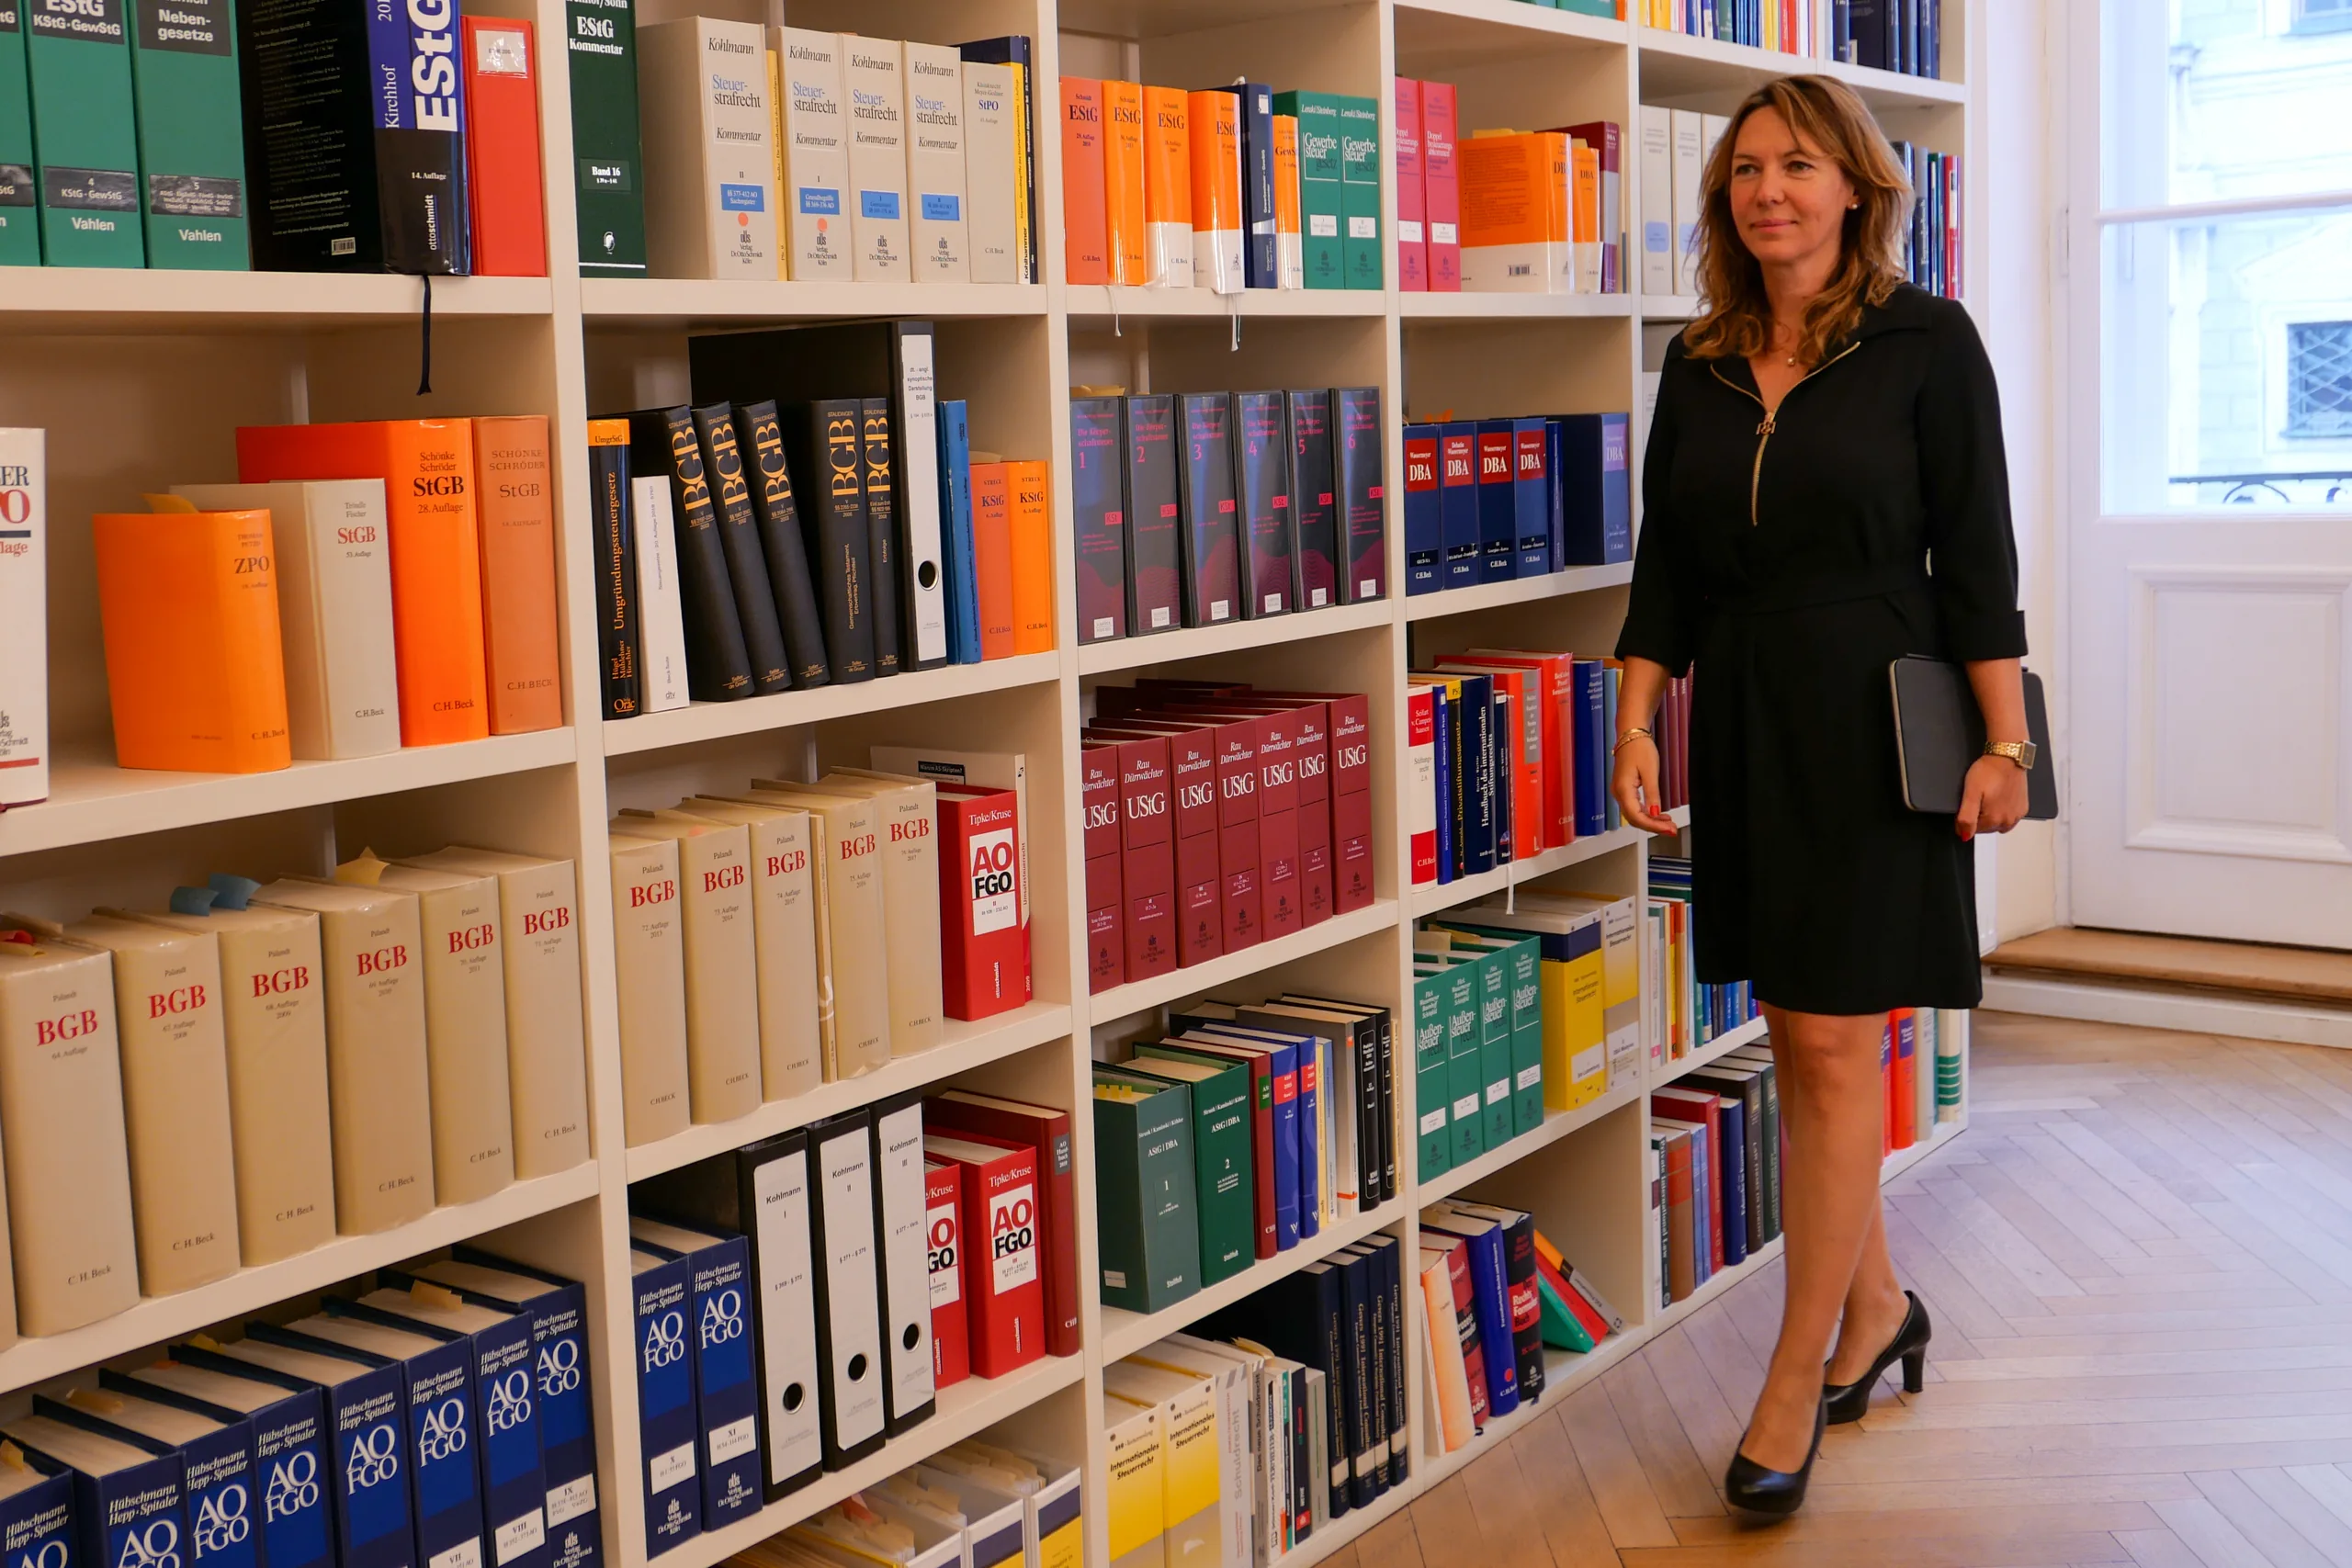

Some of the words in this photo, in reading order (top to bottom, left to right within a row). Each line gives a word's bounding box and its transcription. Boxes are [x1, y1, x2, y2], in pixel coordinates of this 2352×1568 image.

[159, 9, 210, 26] Neben-
[158, 28, 213, 42] gesetze
[576, 16, 614, 38] EStG
[569, 38, 623, 55] Kommentar
[708, 38, 754, 54] Kohlmann
[789, 45, 831, 62] Kohlmann
[407, 0, 458, 131] EStG
[852, 54, 894, 71] Kohlmann
[914, 61, 954, 77] Kohlmann
[712, 73, 748, 91] Steuer-
[793, 81, 826, 98] Steuer-
[381, 64, 400, 129] Kirchhof
[714, 91, 761, 108] strafrecht
[794, 97, 837, 114] strafrecht
[853, 89, 885, 106] Steuer-
[978, 99, 999, 111] StPO
[854, 106, 898, 121] strafrecht
[916, 110, 957, 126] strafrecht
[1069, 105, 1098, 122] EStG
[1114, 107, 1141, 125] EStG
[1158, 112, 1184, 130] EStG
[717, 127, 762, 141] Kommentar
[796, 132, 837, 146] Kommentar
[856, 131, 898, 145] Kommentar
[1305, 132, 1337, 150] Gewerbe
[1305, 145, 1328, 159] steuer
[1344, 136, 1375, 153] Gewerbe
[1344, 149, 1365, 163] steuer
[423, 173, 447, 181] Auflage
[592, 166, 610, 176] Band
[612, 167, 621, 176] 16
[72, 217, 115, 231] Vahlen
[424, 194, 436, 251] ottoschmidt
[178, 229, 221, 243] Vahlen
[595, 434, 623, 445] UmgrStG
[1249, 440, 1257, 456] 4
[1298, 438, 1306, 455] 5
[1348, 434, 1356, 449] 6
[420, 451, 455, 461] Schönke
[828, 419, 858, 499] BGB
[865, 417, 890, 496] BGB
[1079, 451, 1086, 468] 1
[1136, 446, 1146, 463] 2
[1194, 444, 1203, 460] 3
[1607, 446, 1623, 461] DBA
[420, 461, 456, 472] Schröder
[489, 460, 546, 471] SCHRÖDER
[673, 426, 711, 514] BGB
[711, 423, 749, 509] BGB
[755, 422, 792, 506] BGB
[1447, 459, 1469, 477] DBA
[1483, 456, 1507, 474] DBA
[1521, 453, 1541, 470] DBA
[1409, 463, 1431, 481] DBA
[413, 476, 464, 497] StGB
[499, 483, 540, 498] StGB
[981, 494, 1004, 507] KStG
[1020, 491, 1044, 503] KStG
[418, 504, 431, 514] 28.
[432, 502, 463, 513] Auflage
[337, 526, 376, 544] StGB
[608, 472, 626, 631] Umgründungssteuergesetz
[234, 556, 269, 574] ZPO
[1479, 706, 1487, 767] internationalen
[1188, 750, 1199, 761] Rau
[1230, 742, 1241, 751] Rau
[1136, 761, 1150, 770] Rau
[1299, 753, 1325, 779] UStG
[1338, 745, 1366, 769] UStG
[1262, 761, 1293, 787] UStG
[1480, 769, 1488, 782] des
[1223, 772, 1254, 799] UStG
[1181, 782, 1213, 809] UStG
[1127, 792, 1165, 819] UStG
[1481, 783, 1489, 827] Handbuch
[968, 808, 1012, 826] Tipke/Kruse
[1083, 802, 1116, 829] UStG
[889, 818, 930, 842] BGB
[840, 833, 876, 861] BGB
[766, 850, 806, 877] BGB
[972, 841, 1013, 877] AO
[704, 864, 744, 893] BGB
[974, 872, 1012, 898] FGO
[630, 880, 674, 908] BGB
[523, 907, 570, 936] BGB
[447, 923, 493, 953] BGB
[356, 944, 407, 976] BGB
[251, 966, 309, 998] BGB
[148, 985, 206, 1020] BGB
[1485, 997, 1507, 1012] Außen-
[35, 1010, 98, 1046] BGB
[1419, 1023, 1444, 1040] Außen-
[1419, 1033, 1439, 1052] steuer
[889, 1136, 918, 1153] Kohlmann
[1165, 1139, 1178, 1153] DBA
[832, 1162, 864, 1179] Kohlmann
[1225, 1158, 1230, 1169] 2
[989, 1165, 1031, 1188] Tipke/Kruse
[766, 1186, 801, 1205] Kohlmann
[992, 1199, 1033, 1239] AO
[995, 1227, 1032, 1259] FGO
[695, 1261, 740, 1283] Hübschmann
[700, 1289, 741, 1331] AO
[644, 1311, 683, 1354] AO
[701, 1317, 742, 1350] FGO
[481, 1339, 527, 1366] Hübschmann
[644, 1339, 684, 1374] FGO
[486, 1370, 529, 1416] AO
[340, 1391, 393, 1420] Hübschmann
[419, 1398, 465, 1447] AO
[486, 1398, 532, 1437] FGO
[1170, 1412, 1215, 1441] Internationales
[1175, 1425, 1210, 1450] Steuerrecht
[346, 1424, 395, 1472] AO
[419, 1427, 466, 1467] FGO
[1233, 1408, 1242, 1500] Schuldrecht
[187, 1449, 245, 1480] Hübschmann
[1110, 1442, 1159, 1472] Internationales
[265, 1450, 316, 1501] AO
[347, 1455, 398, 1495] FGO
[1117, 1456, 1154, 1481] Steuerrecht
[194, 1483, 247, 1539] AO
[266, 1483, 319, 1524] FGO
[195, 1516, 250, 1560] FGO
